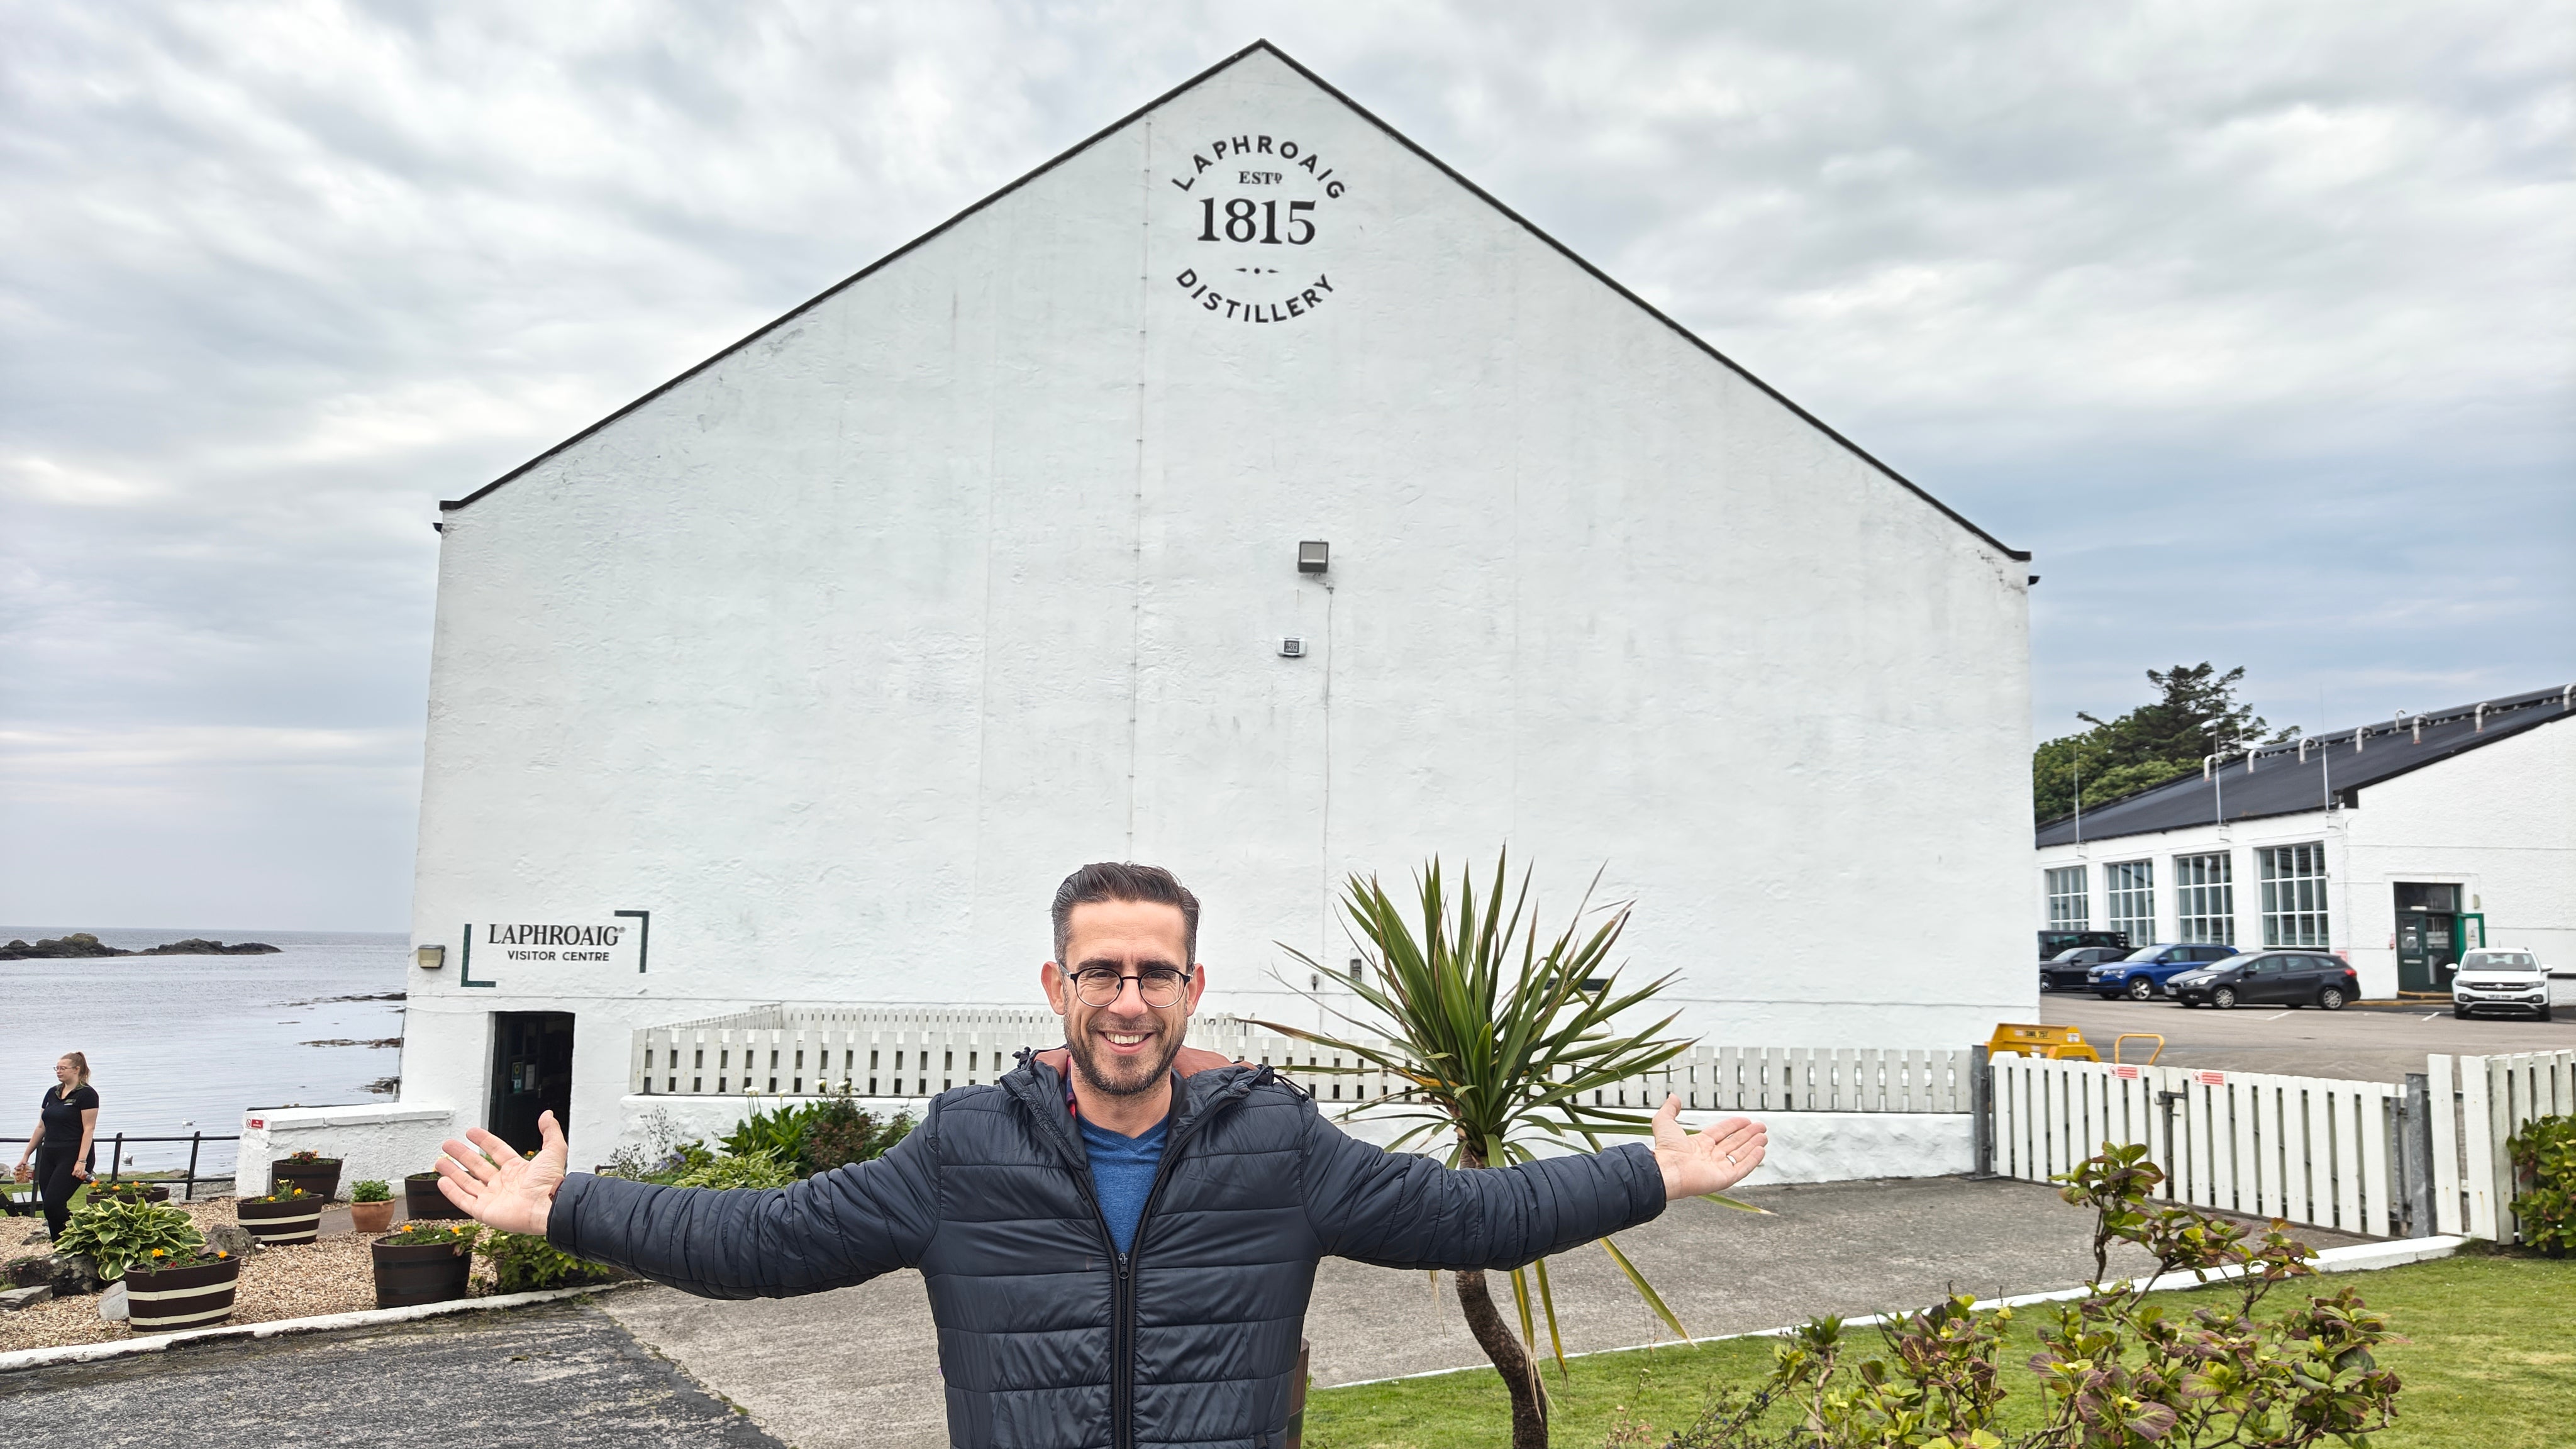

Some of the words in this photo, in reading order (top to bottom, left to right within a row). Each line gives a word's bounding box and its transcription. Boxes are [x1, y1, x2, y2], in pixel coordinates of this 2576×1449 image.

[1171, 135, 1345, 199] LAPHROAIG
[1197, 197, 1316, 245] 1815
[1175, 268, 1333, 323] DISTILLERY
[489, 924, 618, 946] LAPHROAIG
[508, 950, 556, 961] VISITOR
[562, 952, 610, 962] CENTRE
